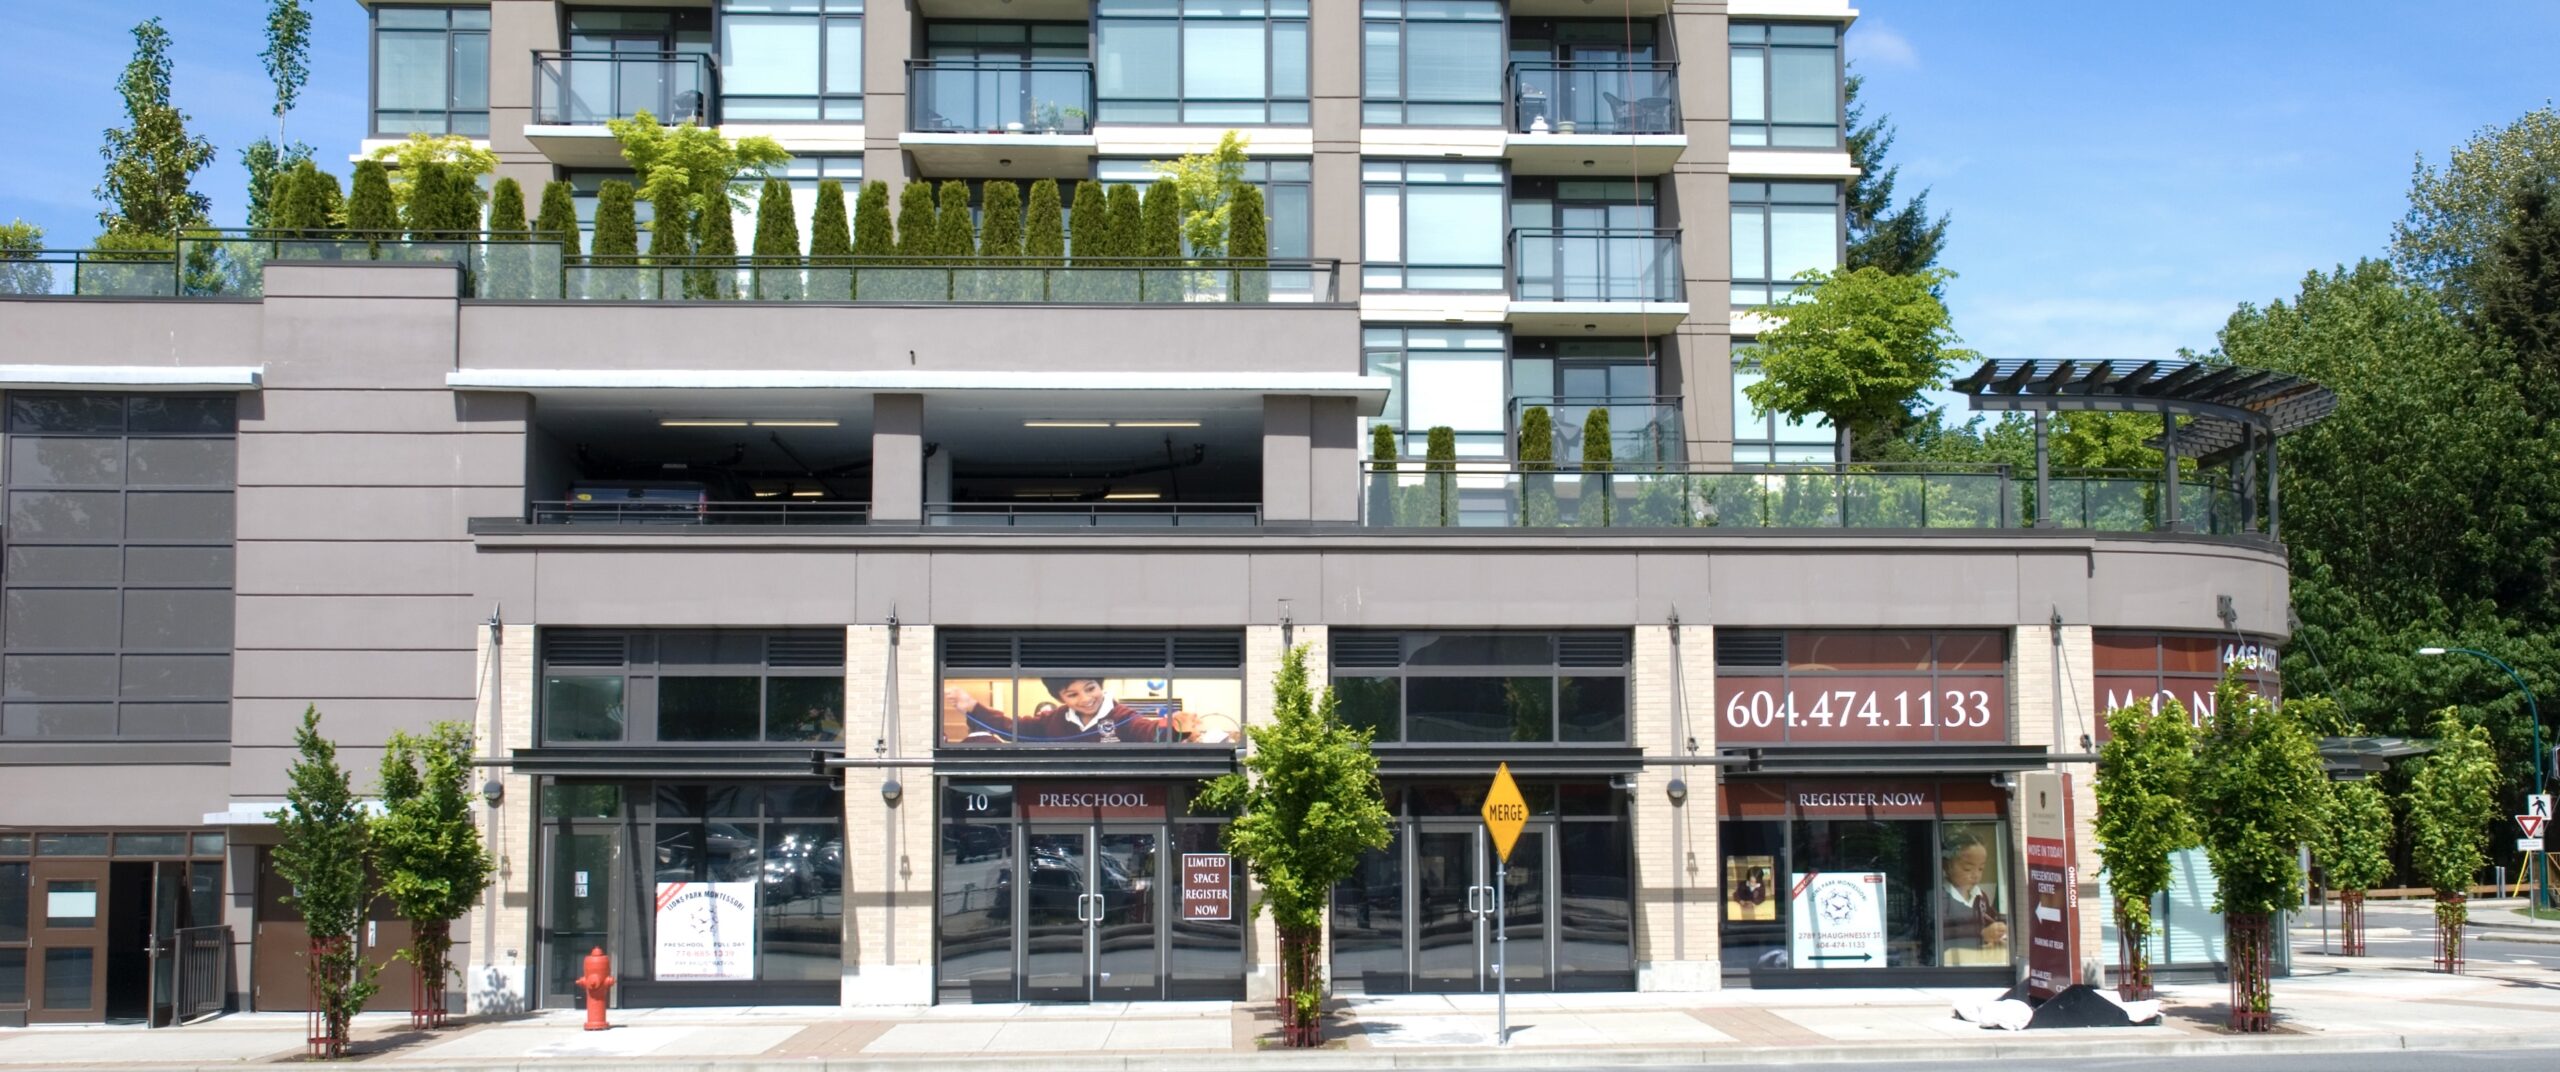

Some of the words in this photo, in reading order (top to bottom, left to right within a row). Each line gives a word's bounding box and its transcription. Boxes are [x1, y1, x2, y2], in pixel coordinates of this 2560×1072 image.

[1726, 690, 1991, 728] 604.474.1133
[966, 794, 988, 811] 10
[1039, 793, 1148, 807] PRESCHOOL
[1799, 793, 1880, 806] REGISTER
[1882, 793, 1925, 806] NOW
[1489, 804, 1523, 821] MERGE
[1187, 857, 1226, 867] LIMITED
[1193, 873, 1220, 883] SPACE
[1185, 889, 1228, 899] REGISTER
[2068, 866, 2077, 908] ONNI.COM
[667, 897, 685, 910] LIONS
[685, 891, 702, 900] PARK
[1194, 905, 1219, 915] NOW
